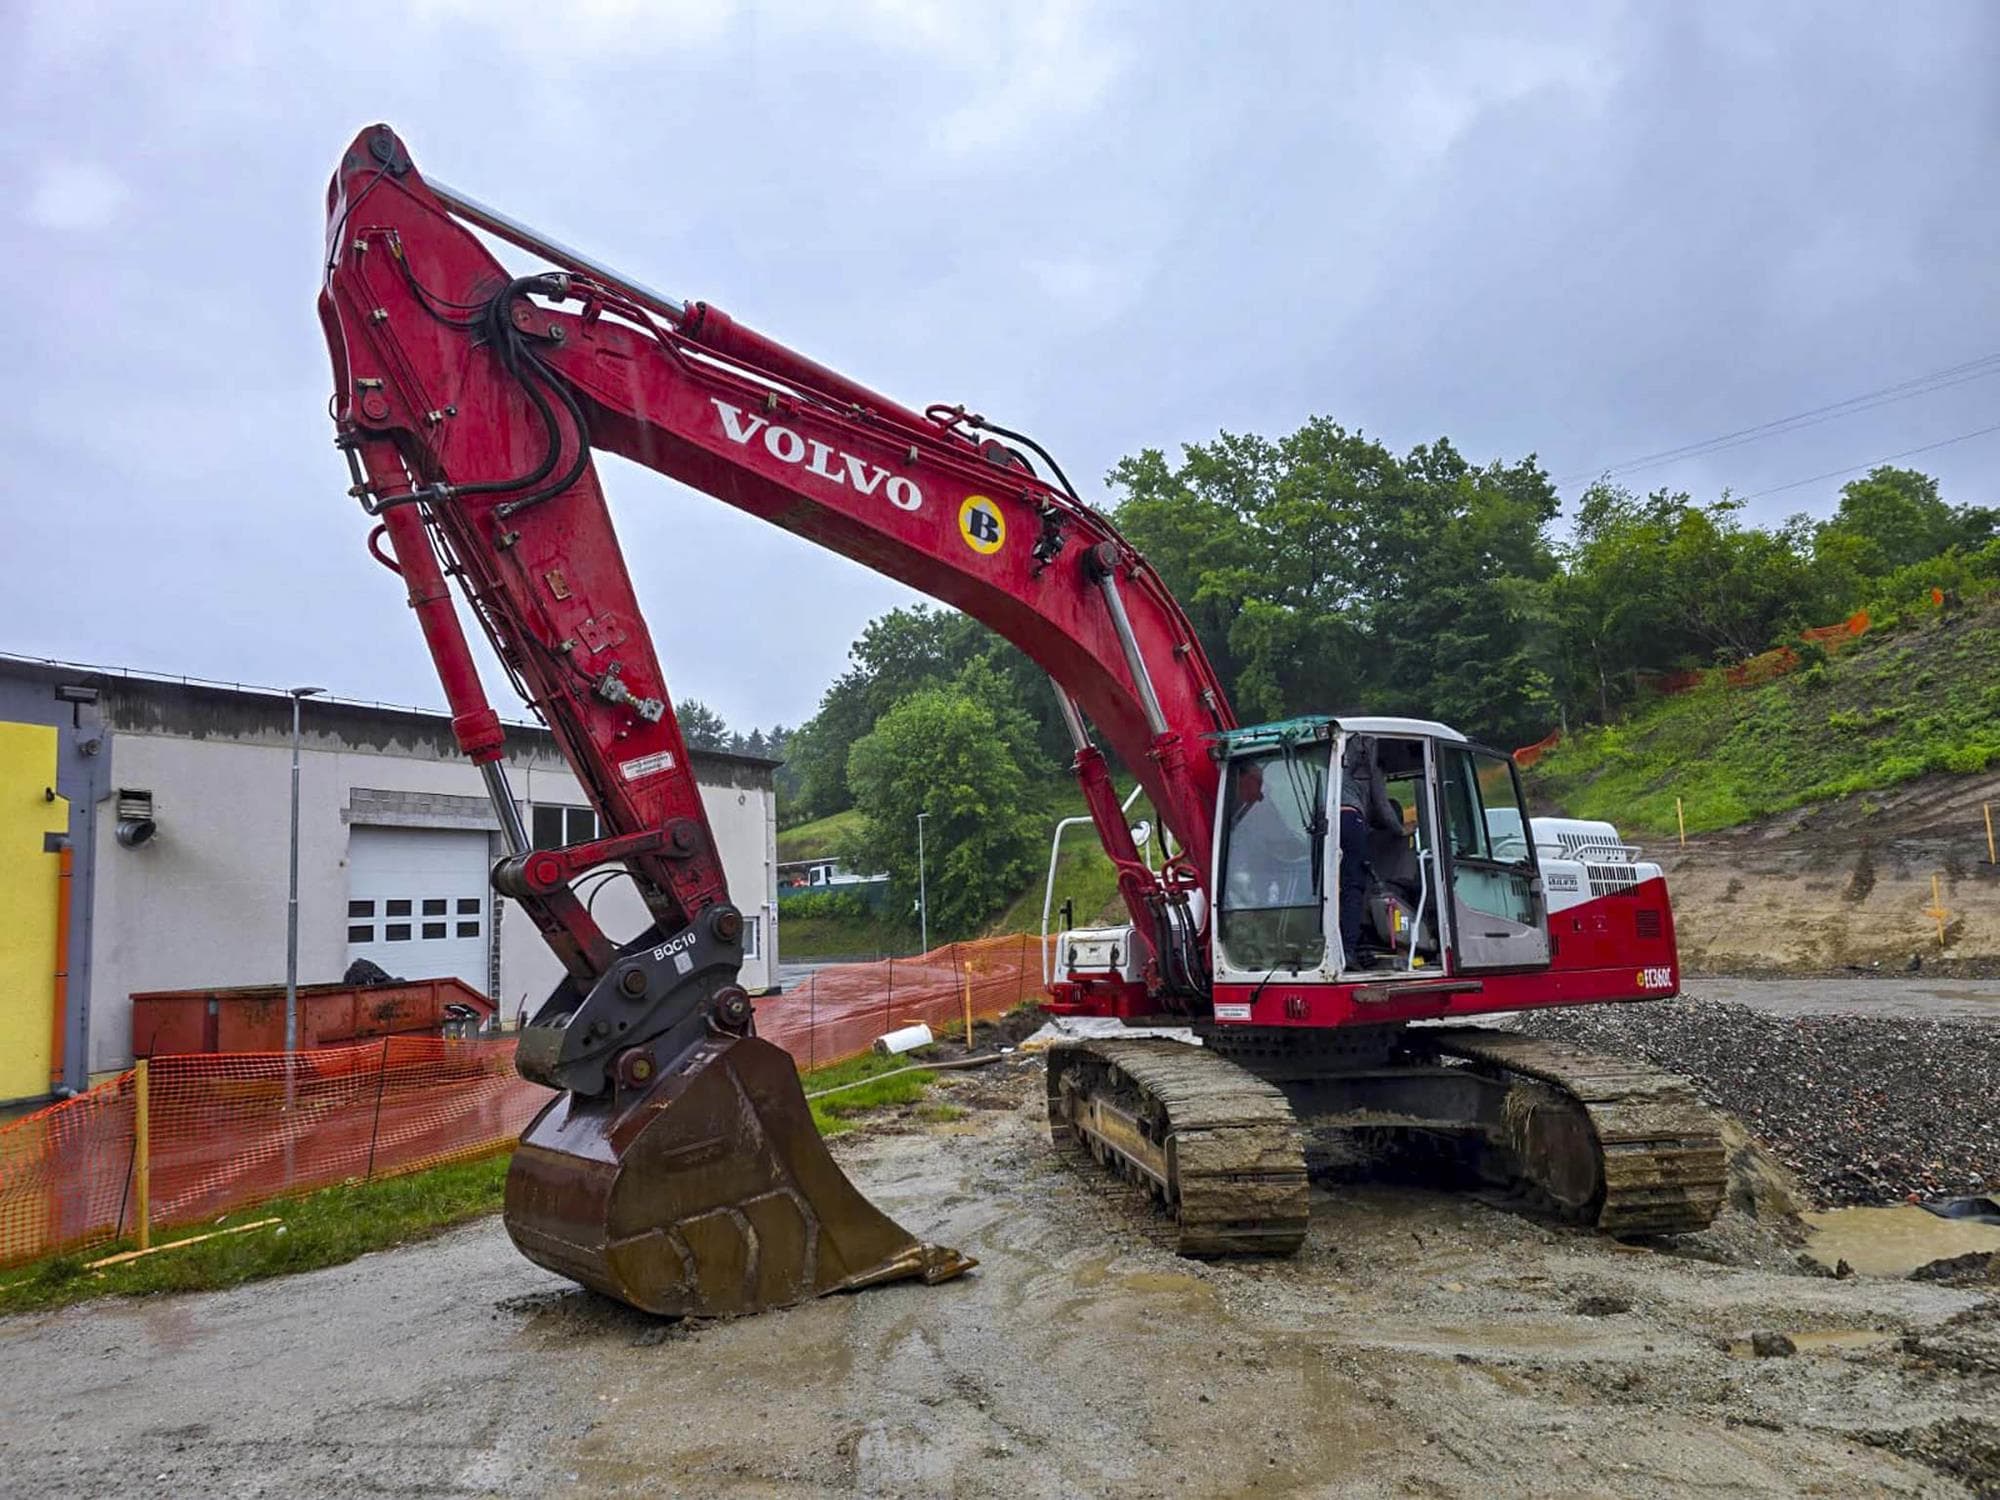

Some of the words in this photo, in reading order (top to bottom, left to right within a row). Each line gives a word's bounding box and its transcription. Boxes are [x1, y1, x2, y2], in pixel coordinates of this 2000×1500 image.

[710, 397, 922, 512] VOLVO
[968, 506, 999, 543] B
[653, 932, 696, 961] BQC10
